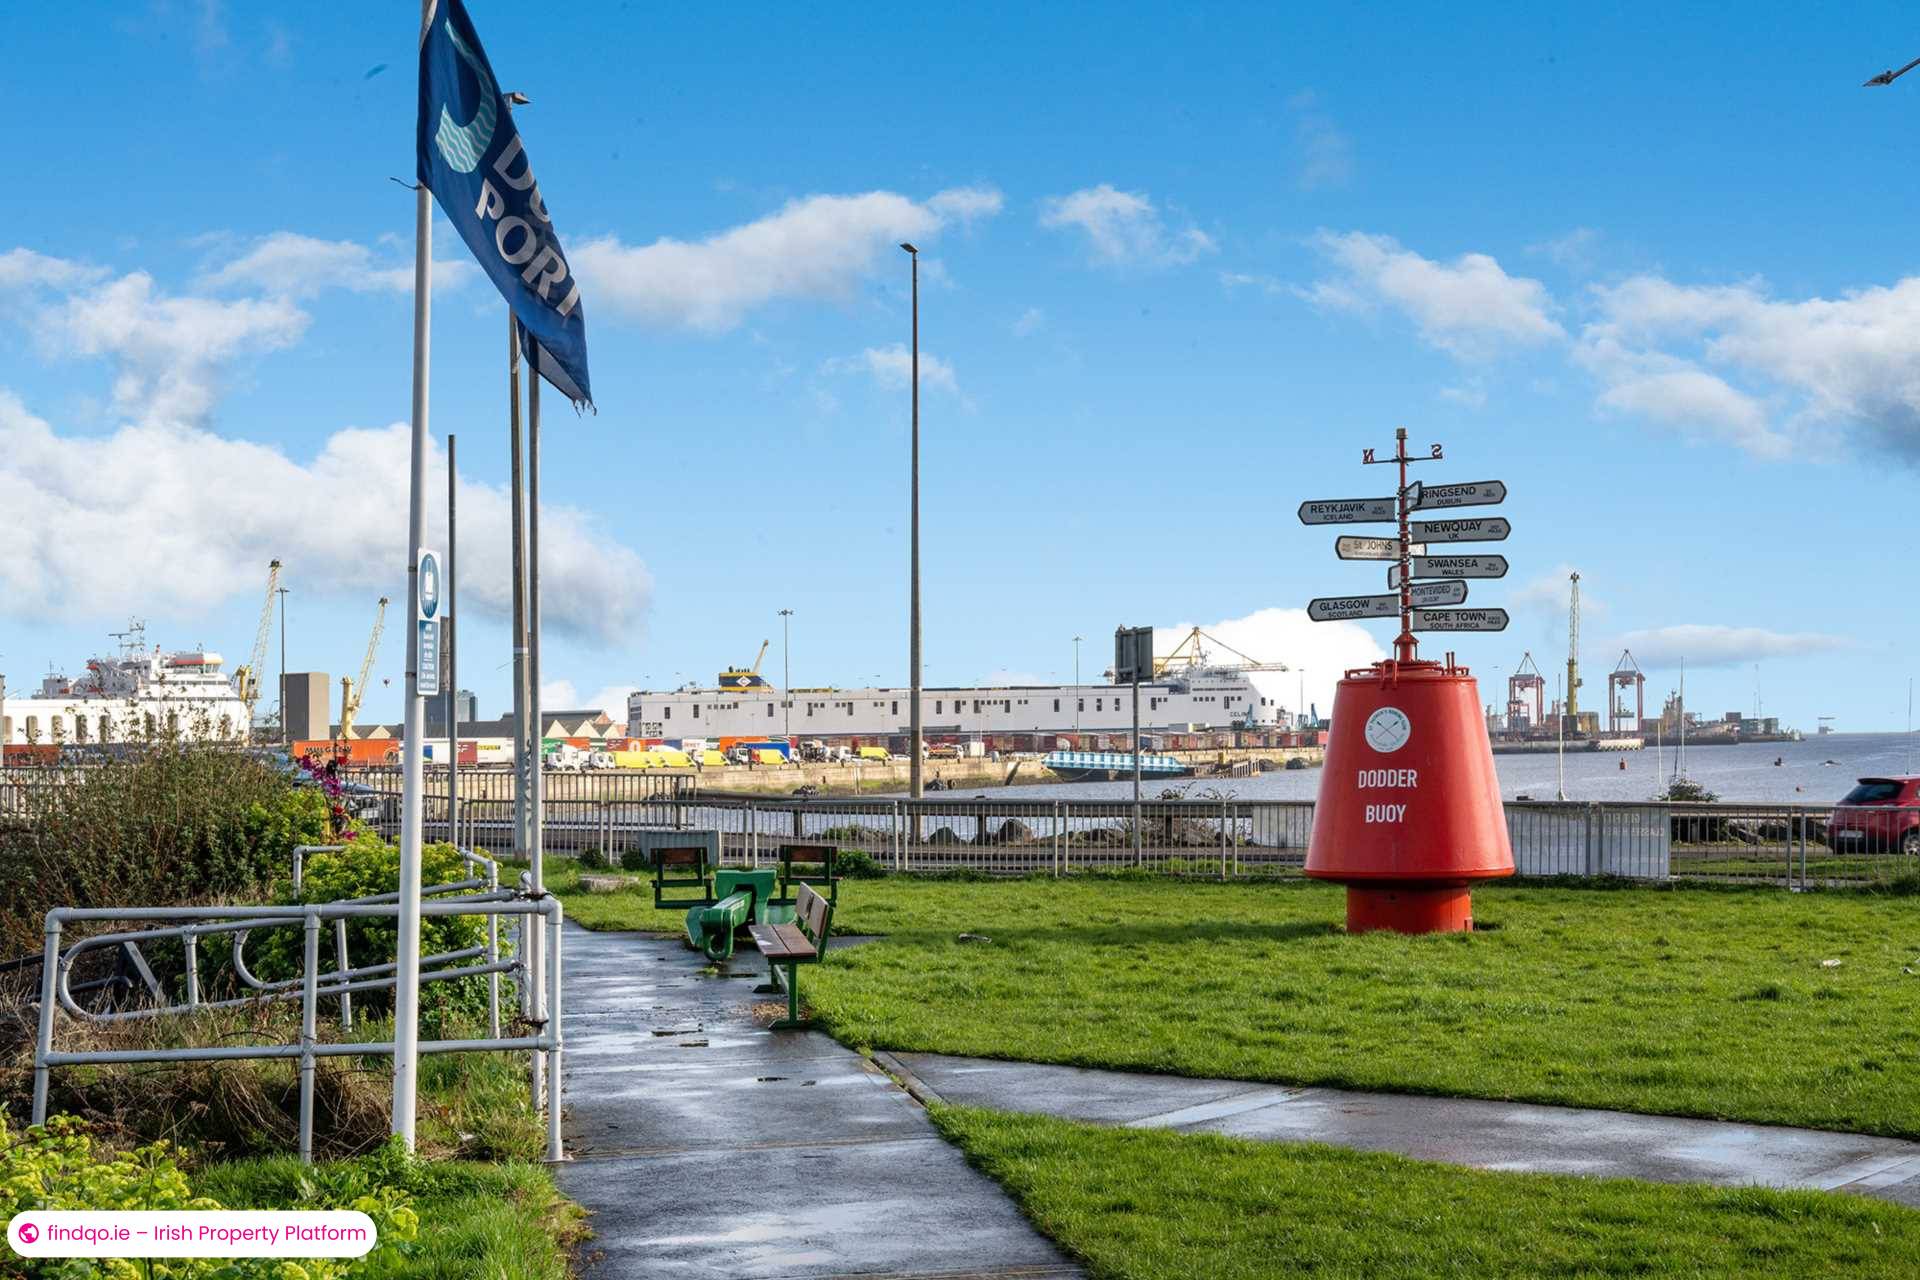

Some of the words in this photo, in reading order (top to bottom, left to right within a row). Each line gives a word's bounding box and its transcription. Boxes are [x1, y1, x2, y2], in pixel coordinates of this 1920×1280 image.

[1422, 486, 1476, 499] RINGSEND
[1310, 502, 1366, 513] REYKJAVIK
[1323, 513, 1354, 521] ICELAND
[1424, 520, 1482, 533] NEWQUAY
[1427, 559, 1479, 569] SWANSEA
[1319, 599, 1370, 611] GLASGOW
[1328, 610, 1364, 618] SCOTLAND
[1423, 612, 1451, 622] CAPE
[1455, 611, 1487, 622] TOWN
[1358, 769, 1418, 788] DODDER
[1365, 804, 1407, 823] BUOY
